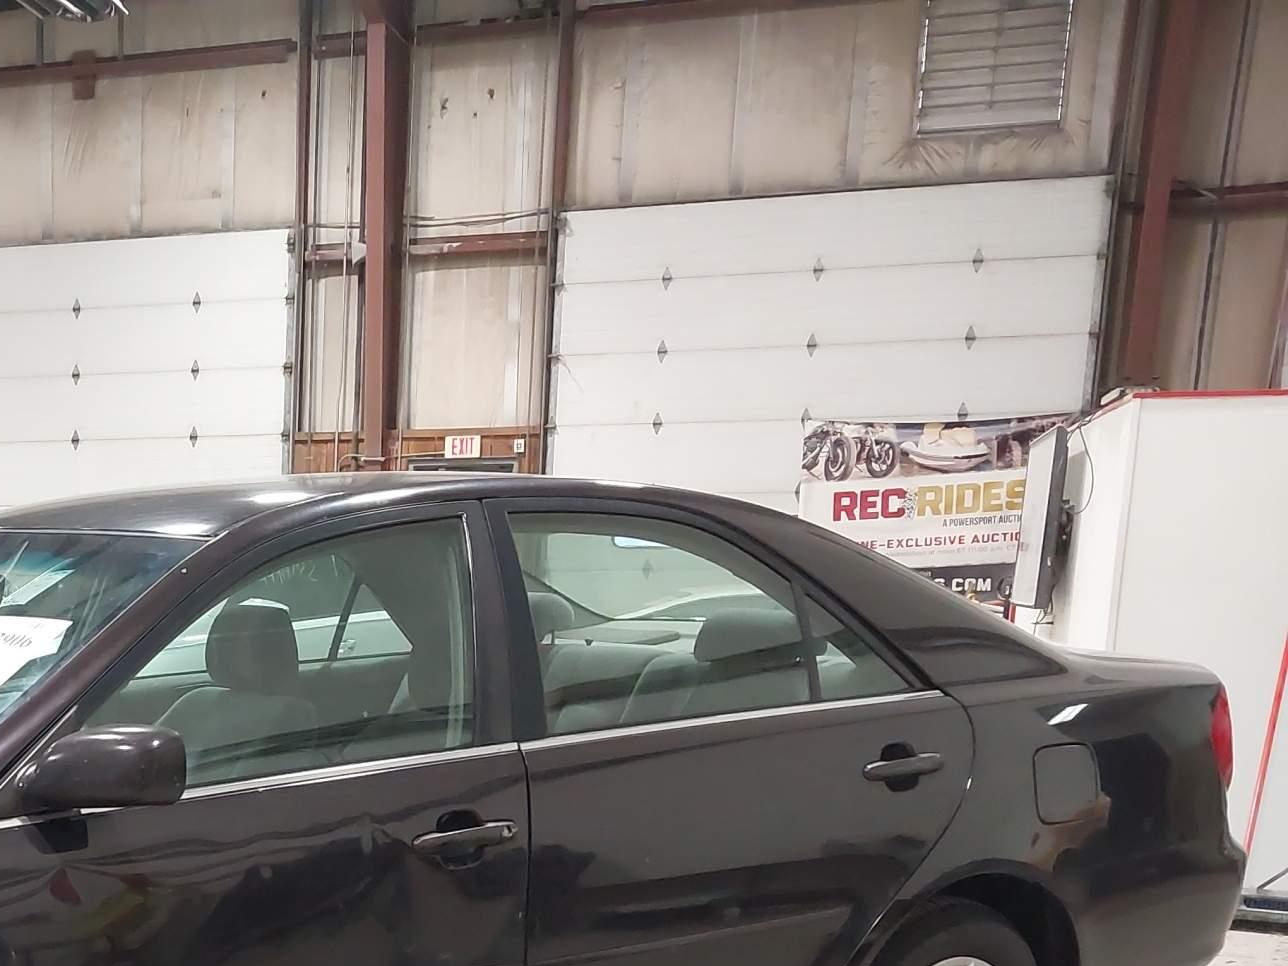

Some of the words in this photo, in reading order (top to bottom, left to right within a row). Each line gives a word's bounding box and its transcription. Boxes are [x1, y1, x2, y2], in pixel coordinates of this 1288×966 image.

[451, 437, 475, 455] EXIT
[833, 488, 907, 521] REC
[917, 479, 1027, 516] RIDES
[942, 519, 948, 527] A
[949, 516, 997, 527] POWERSPORT
[857, 535, 966, 549] NE-EXCLUSIVE
